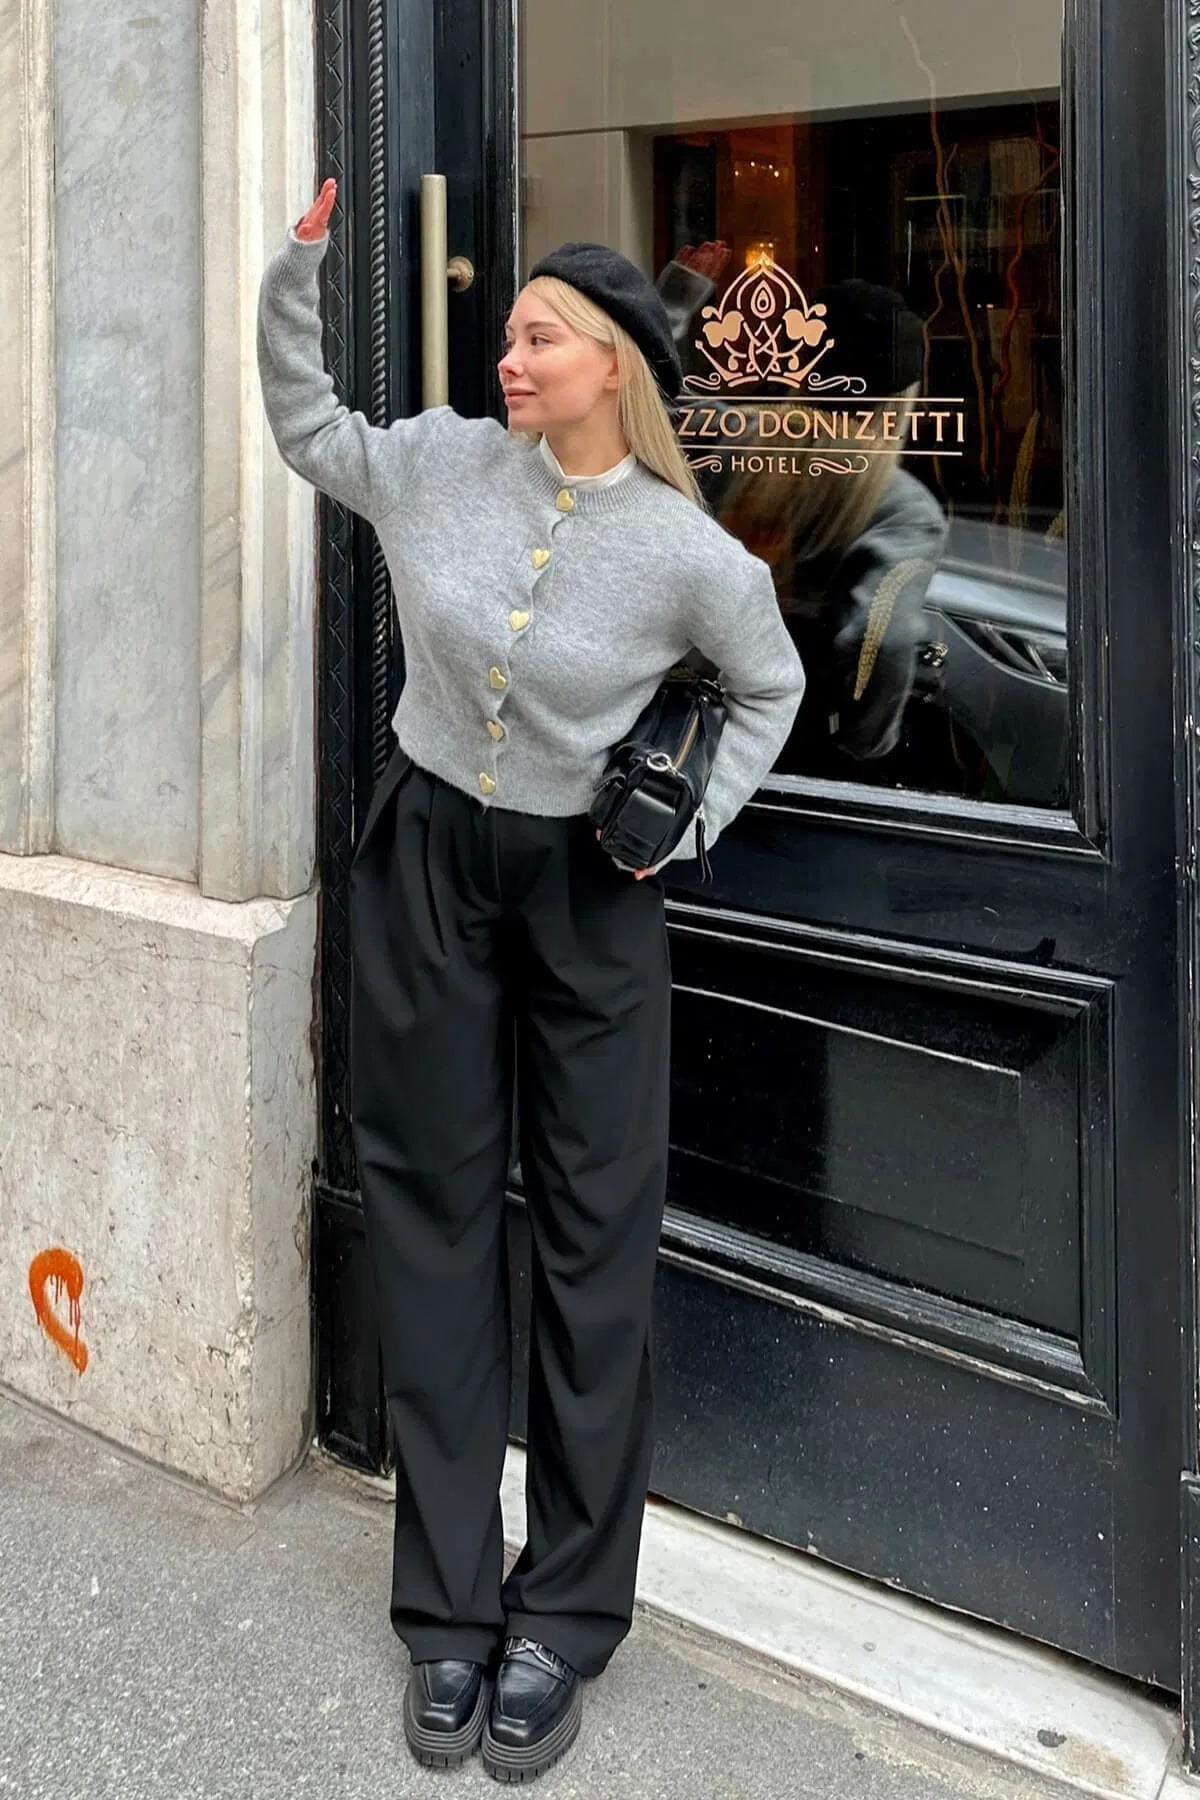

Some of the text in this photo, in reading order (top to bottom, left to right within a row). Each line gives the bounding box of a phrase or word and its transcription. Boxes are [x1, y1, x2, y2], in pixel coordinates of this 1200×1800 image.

[677, 408, 964, 442] ZZO DONIZETTI
[731, 455, 802, 475] HOTEL
